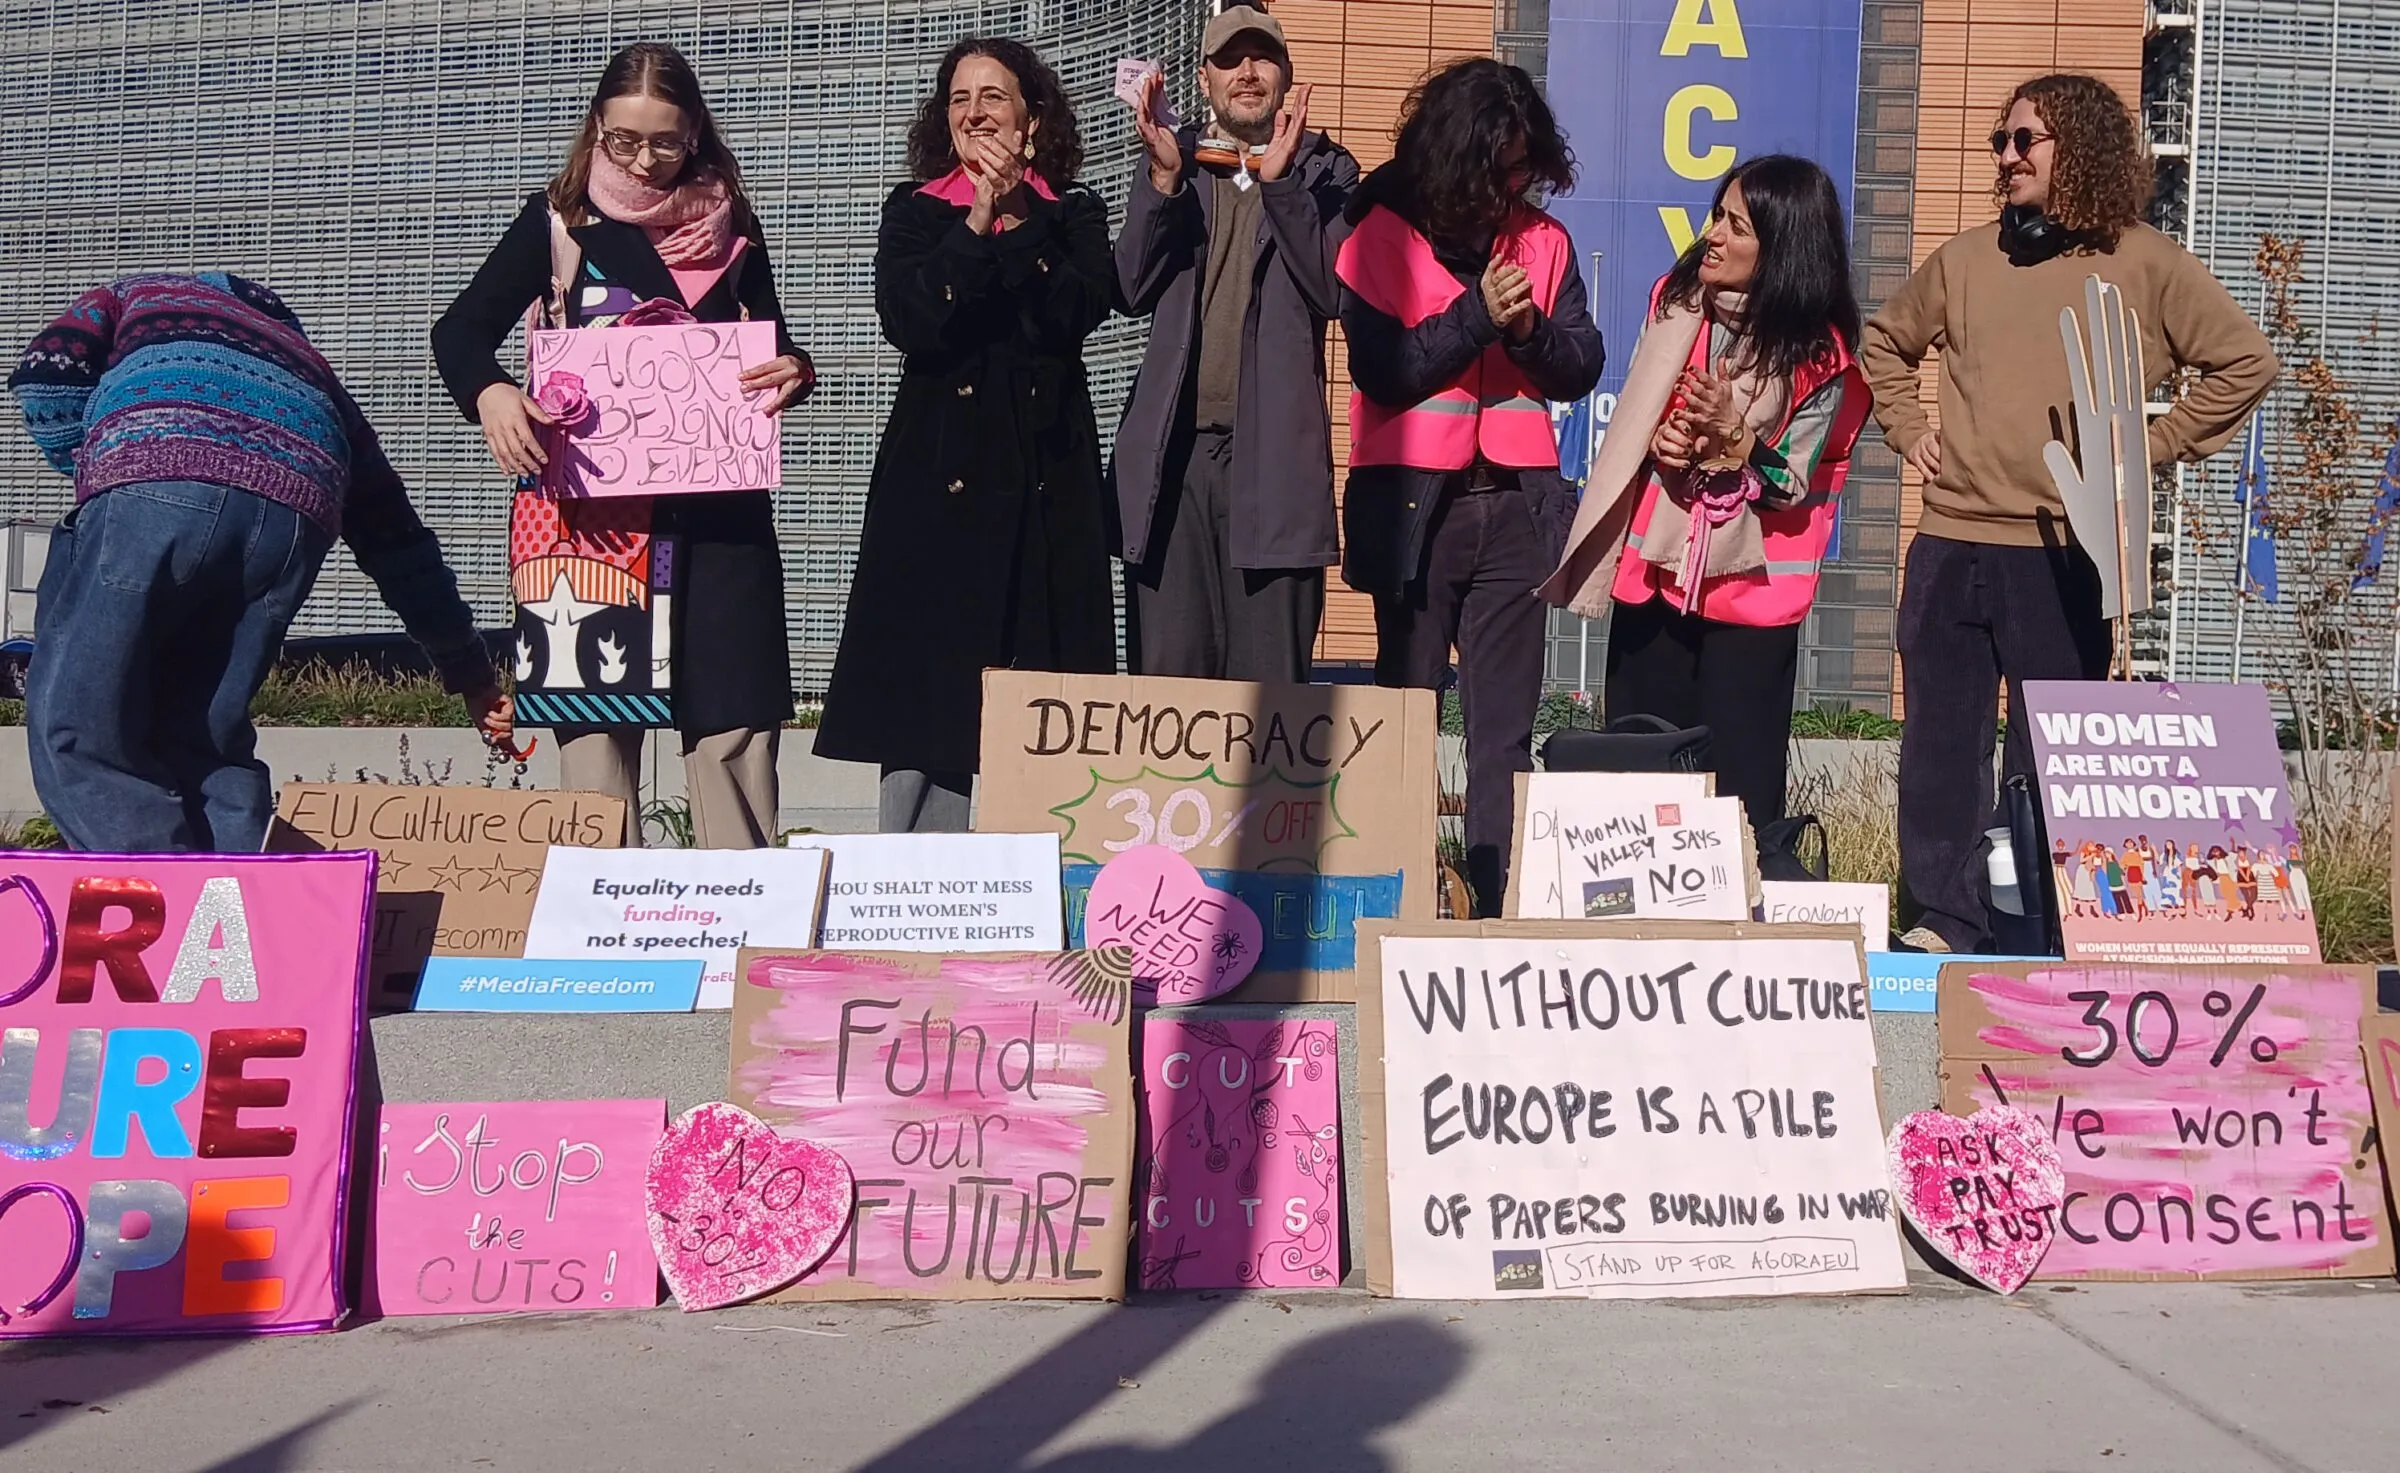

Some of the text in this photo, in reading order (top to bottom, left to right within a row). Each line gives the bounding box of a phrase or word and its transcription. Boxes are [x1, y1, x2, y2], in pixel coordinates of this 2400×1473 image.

[583, 327, 762, 402] AGORA
[570, 437, 628, 485] TO
[636, 444, 780, 488] EVERYONE
[1023, 698, 1384, 769] DEMOCRACY
[2035, 712, 2219, 748] WOMEN
[2045, 754, 2200, 778] ARE NOT A
[289, 790, 605, 847] EU Culture Cuts
[1102, 787, 1323, 854] 30% OFF
[2048, 784, 2279, 821] MINORITY
[1565, 814, 1648, 851] MOOMIN
[1583, 829, 1722, 878] VALLEY SAYS
[592, 878, 764, 900] Equality needs
[850, 902, 998, 918] WITH WOMEN'S
[873, 881, 934, 896] SHALT
[939, 880, 978, 895] NOT
[983, 880, 1033, 894] MESS
[1148, 875, 1228, 943] WE
[623, 904, 722, 926] funding,
[815, 924, 1035, 943] REPRODUCTIVE RIGHTS
[1098, 904, 1200, 968] NEED
[1771, 904, 1864, 927] ECONOMY
[586, 930, 749, 952] not speeches!
[2075, 943, 2310, 955] WOMEN MUST BE EQUALLY REPRESENTED
[458, 974, 656, 996] #MediaFreedom
[1398, 961, 1868, 1034] WITHOUT CULTURE
[2059, 982, 2279, 1069] 30%
[837, 998, 1039, 1103] Fund
[1162, 1051, 1304, 1090] CUT
[1420, 1073, 1838, 1155] EUROPE IS A PILE
[2173, 1087, 2328, 1150] won't
[892, 1114, 1010, 1170] our
[1937, 1133, 2008, 1167] ASK
[710, 1137, 806, 1212] NO
[1950, 1171, 2020, 1214] PAY
[464, 1213, 526, 1250] the
[848, 1171, 1115, 1286] FUTURE
[1147, 1196, 1309, 1232] CUTS
[1423, 1187, 1895, 1240] OF PAPERS BURNING IN WAR
[1946, 1204, 2058, 1251] TRUST
[2060, 1180, 2367, 1247] consent
[1564, 1252, 1850, 1282] STAND UP FOR AGORAEU
